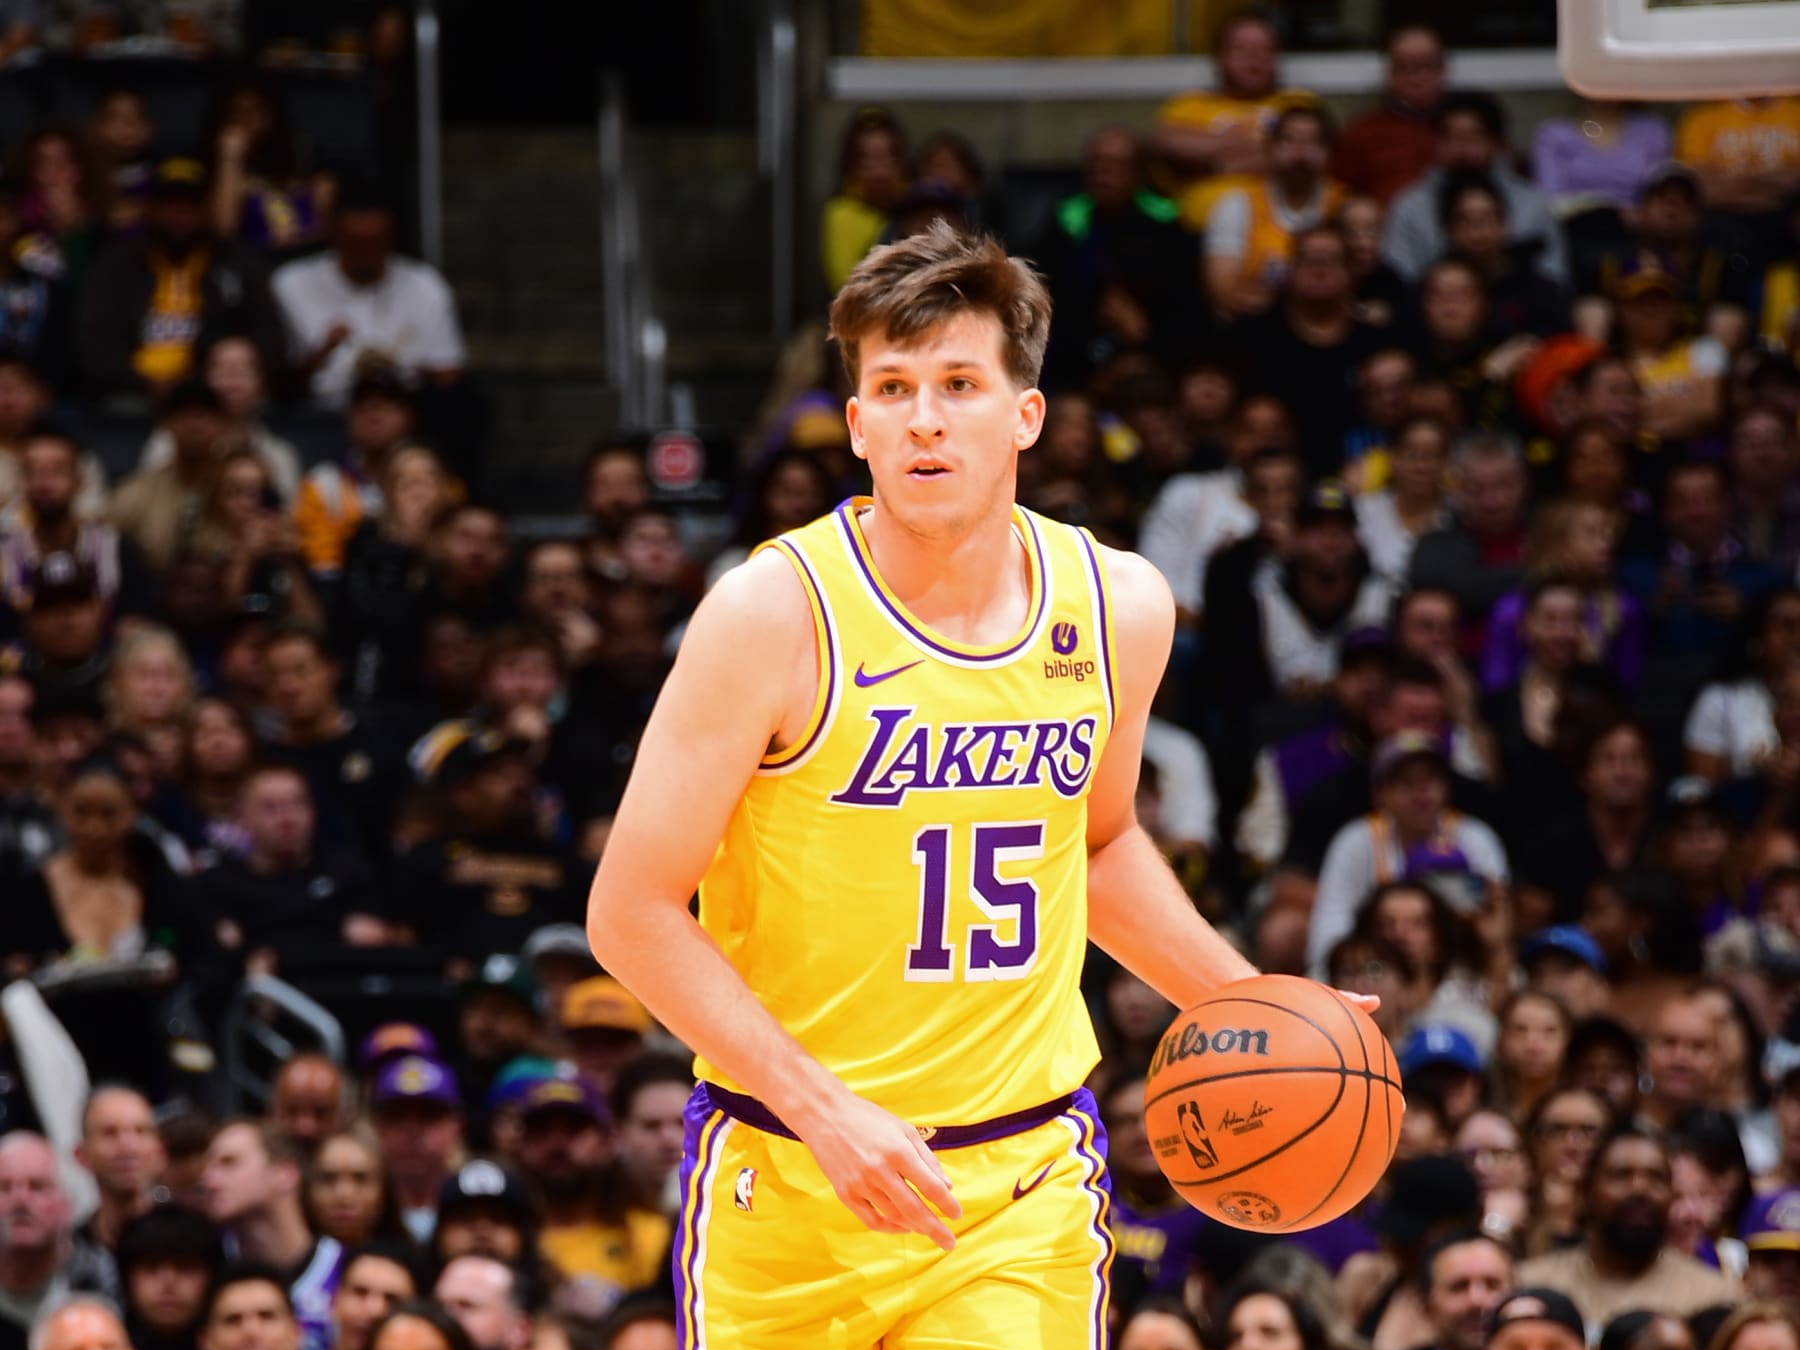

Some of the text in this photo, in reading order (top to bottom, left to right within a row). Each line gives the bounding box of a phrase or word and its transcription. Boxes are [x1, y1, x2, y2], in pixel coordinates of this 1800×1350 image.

[1044, 659, 1095, 682] bibigo
[827, 704, 1098, 808] LAKERS
[903, 819, 1048, 982] 15
